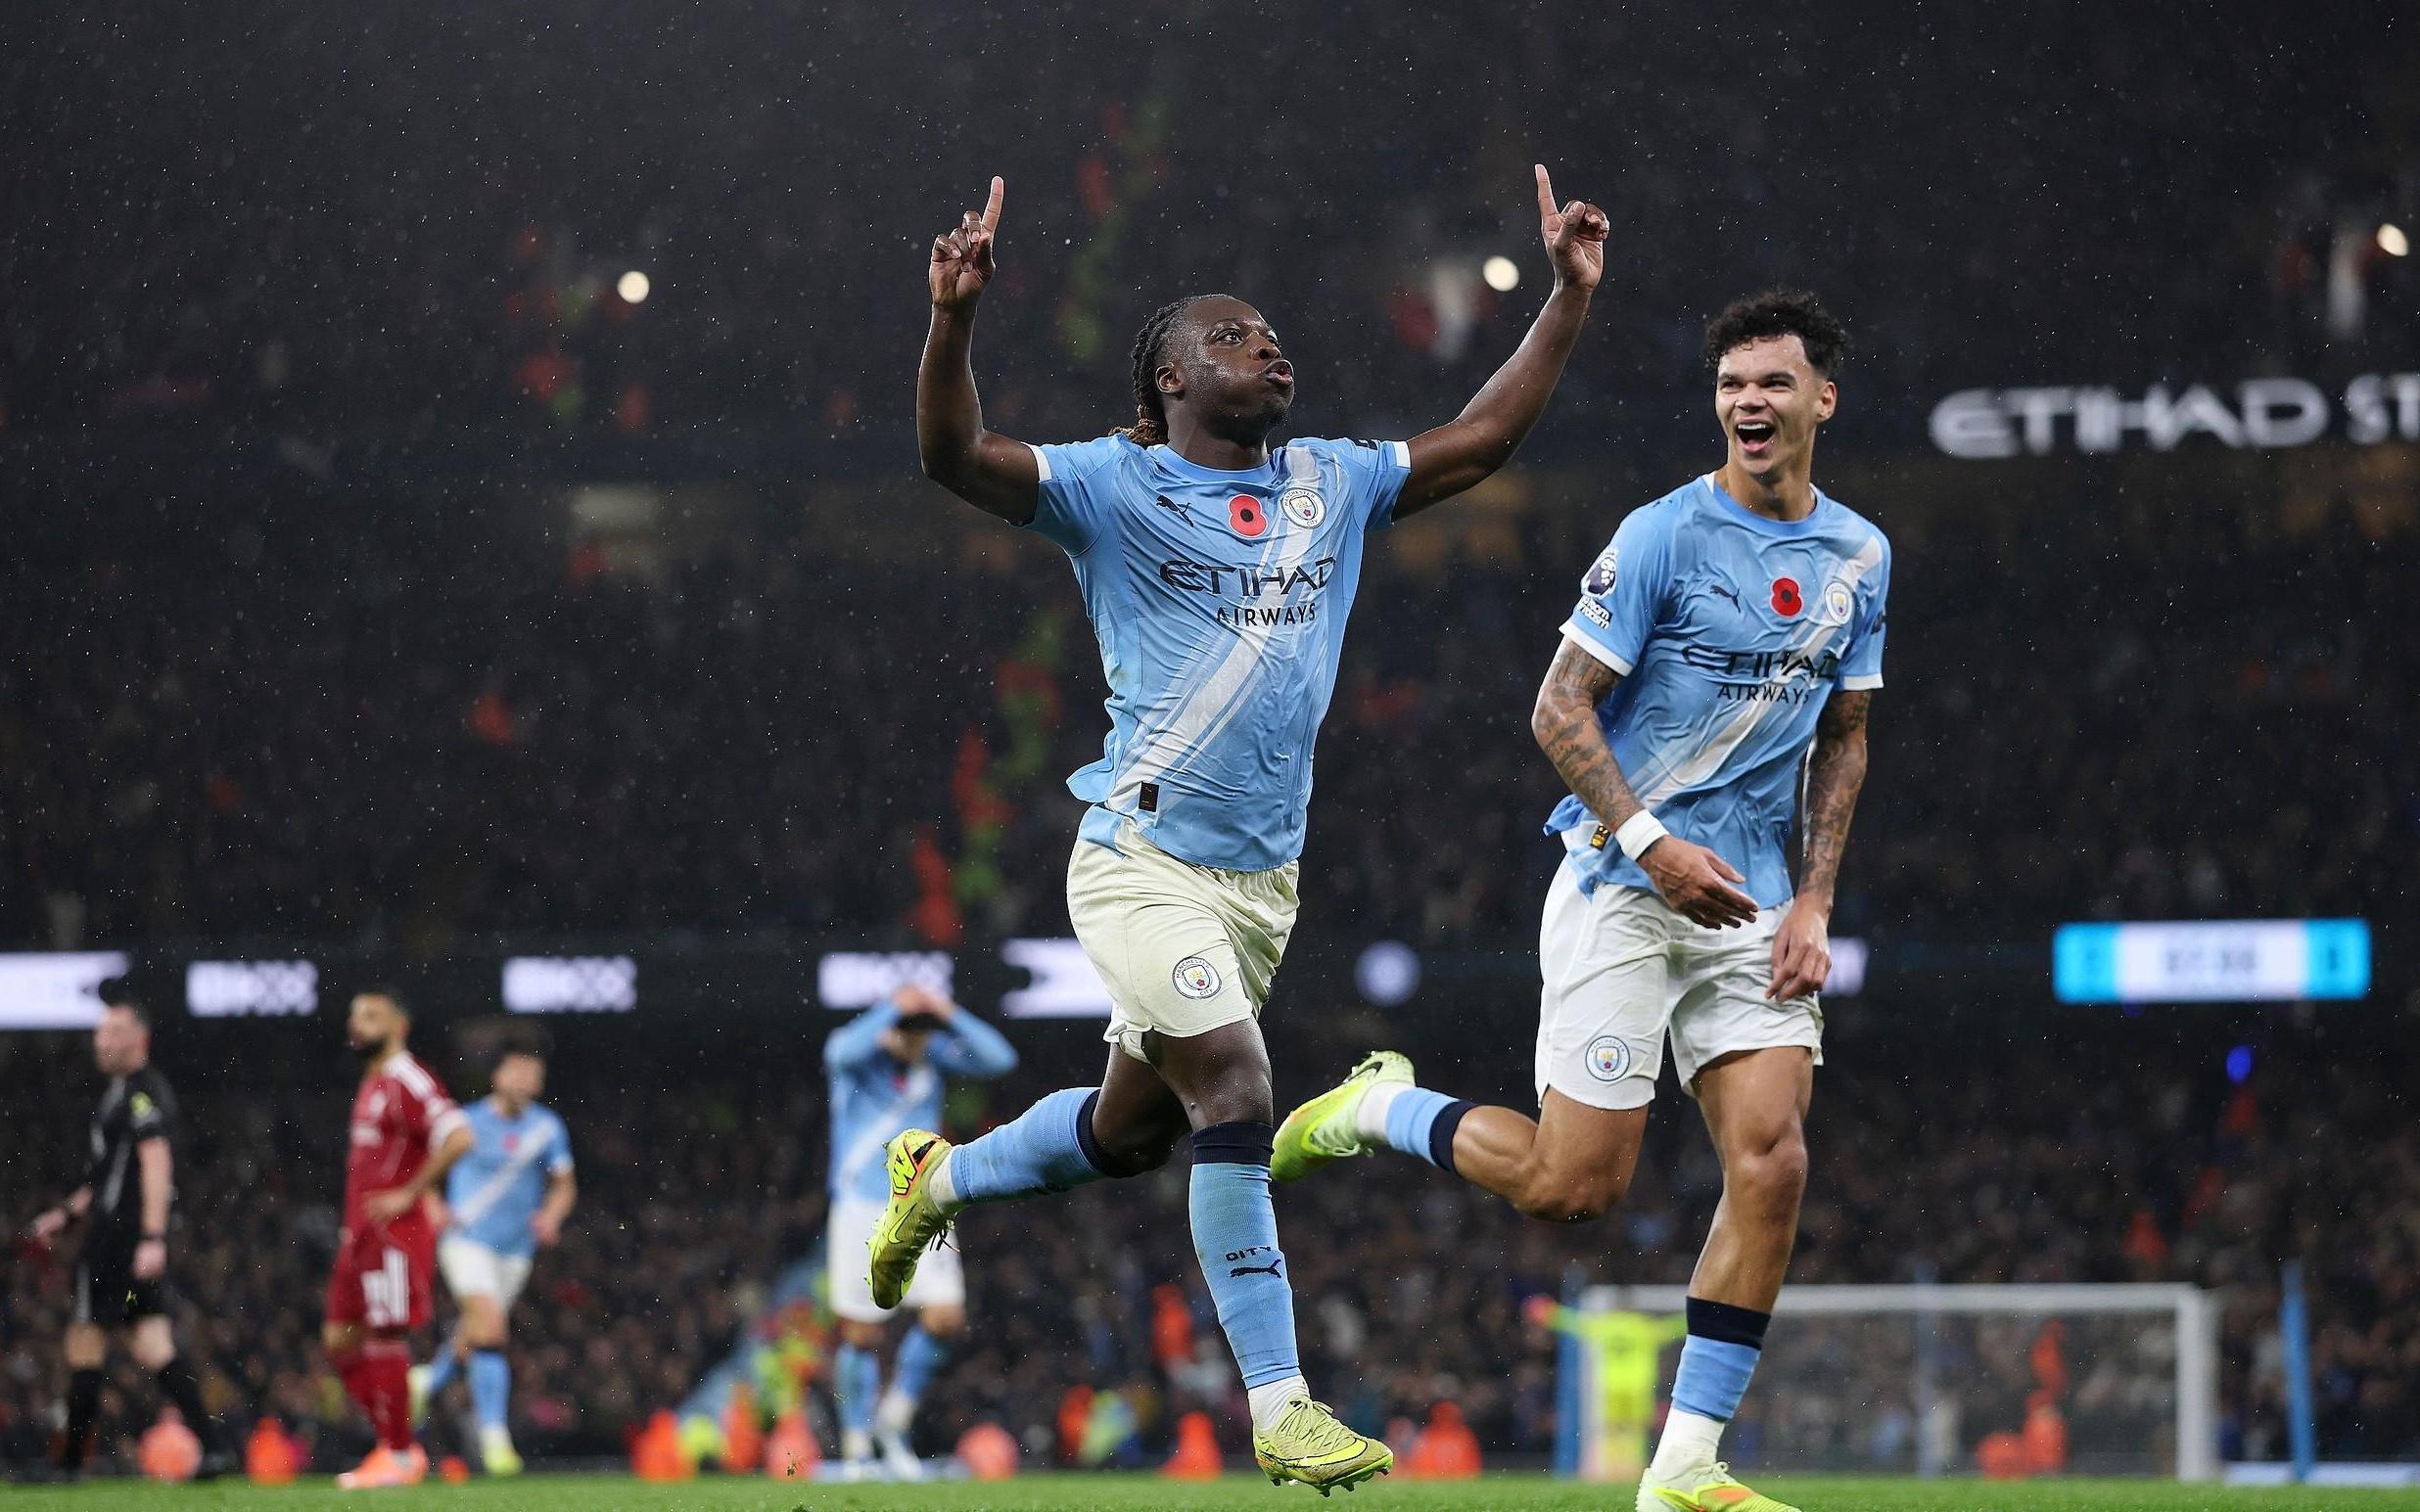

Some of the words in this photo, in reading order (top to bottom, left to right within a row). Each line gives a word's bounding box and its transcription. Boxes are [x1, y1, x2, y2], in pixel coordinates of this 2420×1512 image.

[1929, 377, 2330, 458] ETIHAD
[1159, 556, 1336, 597] ETIHAD
[1217, 602, 1316, 626] AIRWAYS
